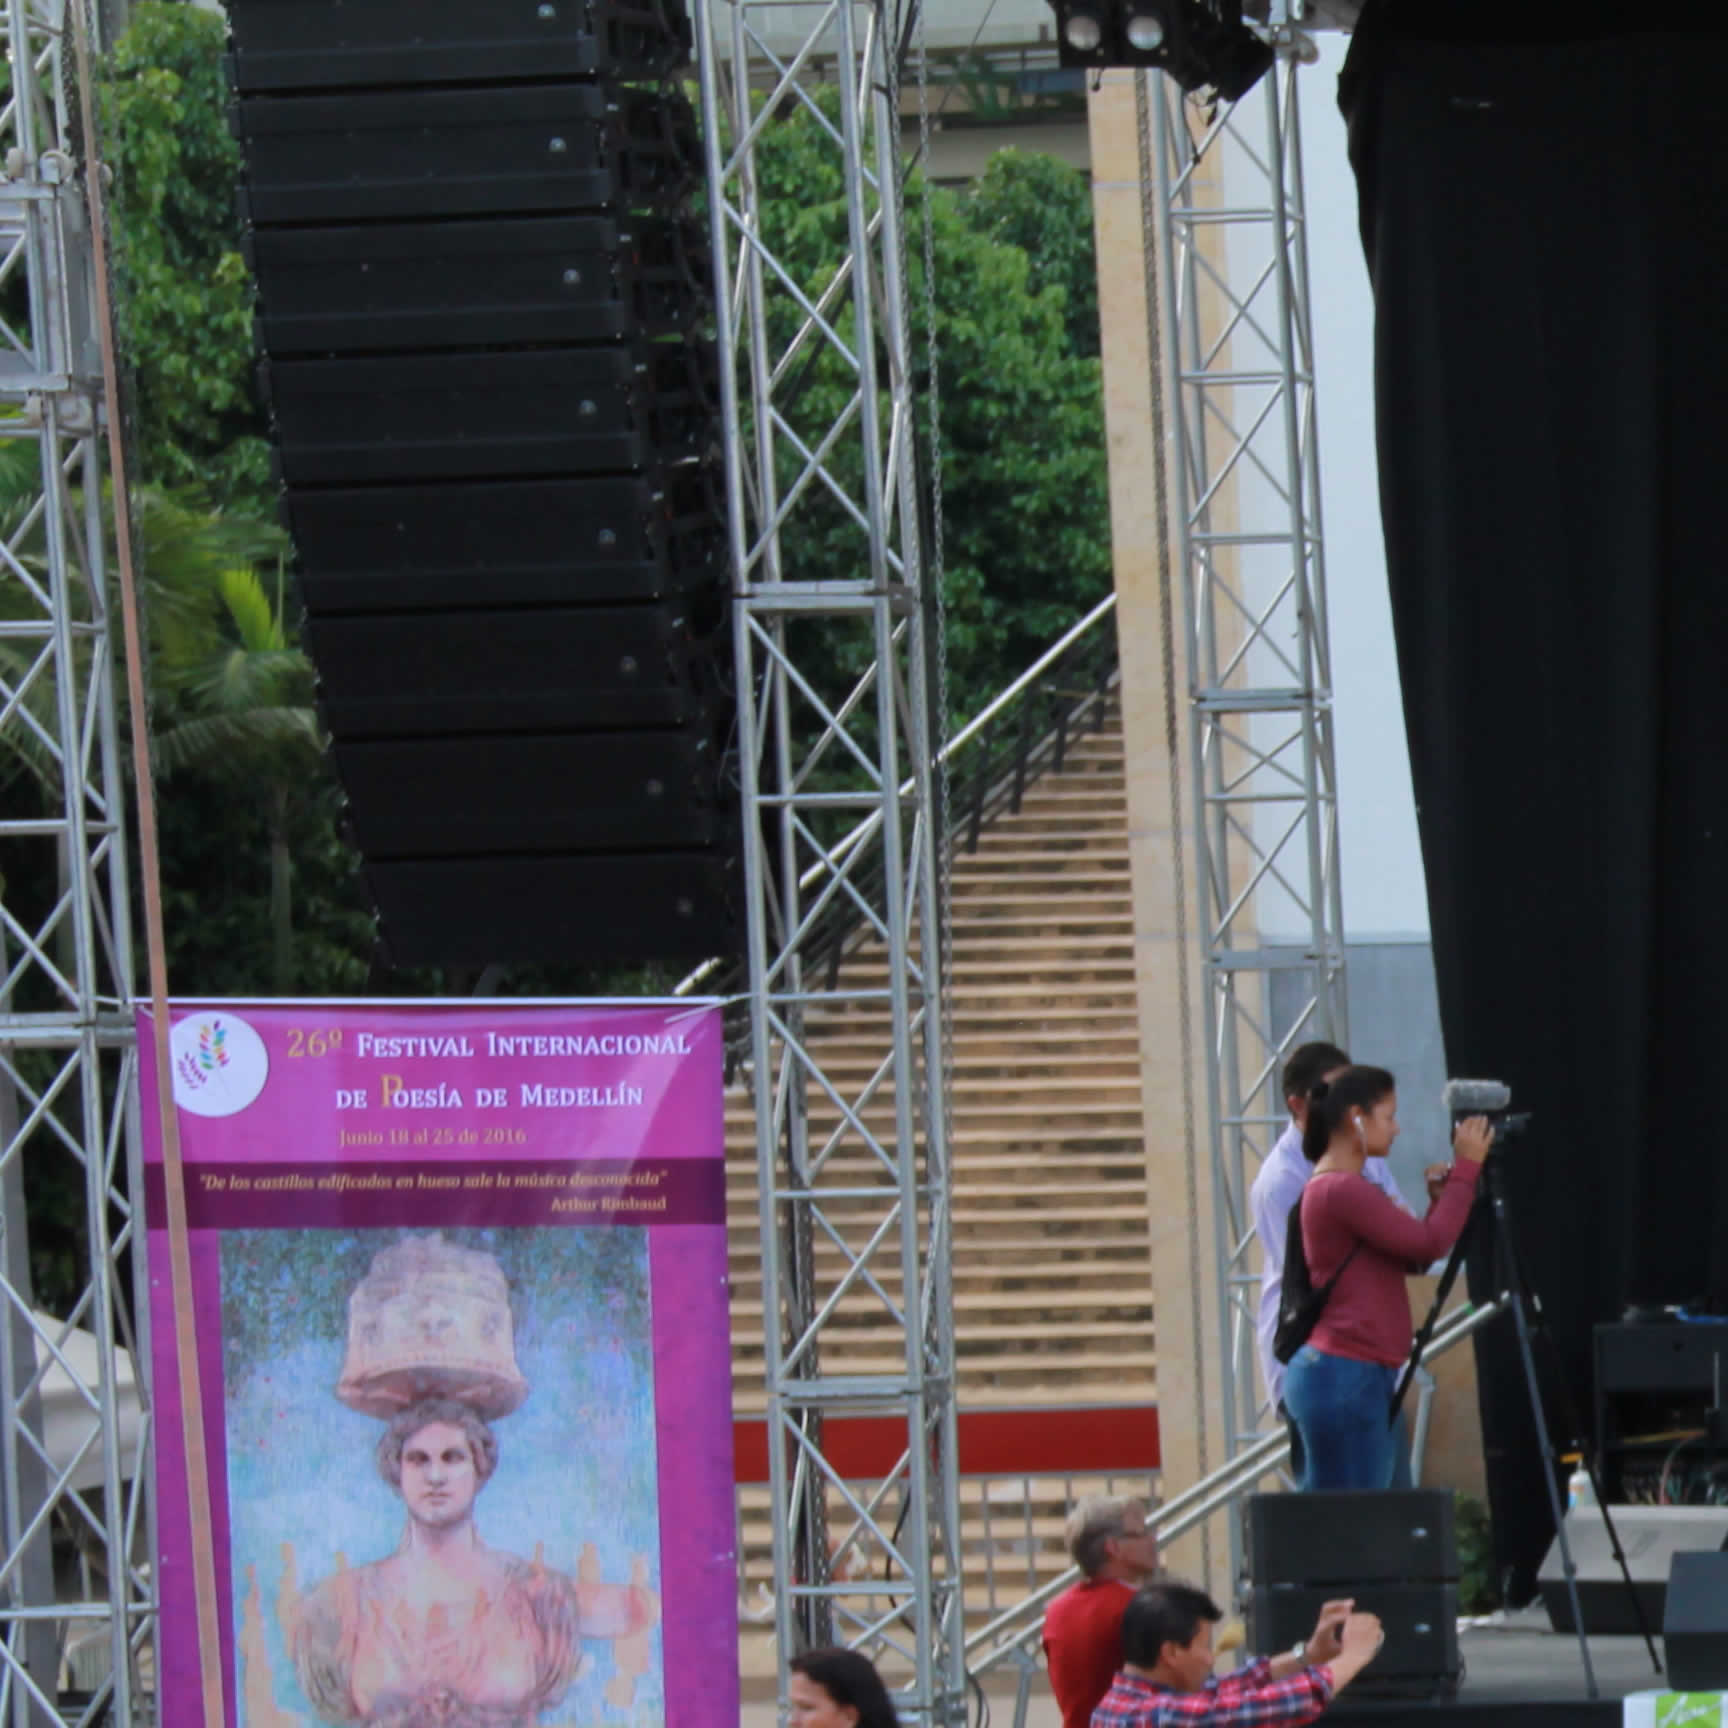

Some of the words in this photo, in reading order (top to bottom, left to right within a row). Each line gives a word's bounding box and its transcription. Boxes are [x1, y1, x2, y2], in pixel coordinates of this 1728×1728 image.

[287, 1030, 343, 1059] 26º
[358, 1033, 475, 1058] FESTIVAL
[488, 1032, 692, 1058] INTERNACIONAL
[336, 1089, 368, 1109] DE
[380, 1073, 463, 1110] POESÍA
[476, 1089, 508, 1108] DE
[521, 1081, 644, 1108] MEDELLÍN
[340, 1127, 384, 1151] Junio
[483, 1127, 529, 1146] 2016
